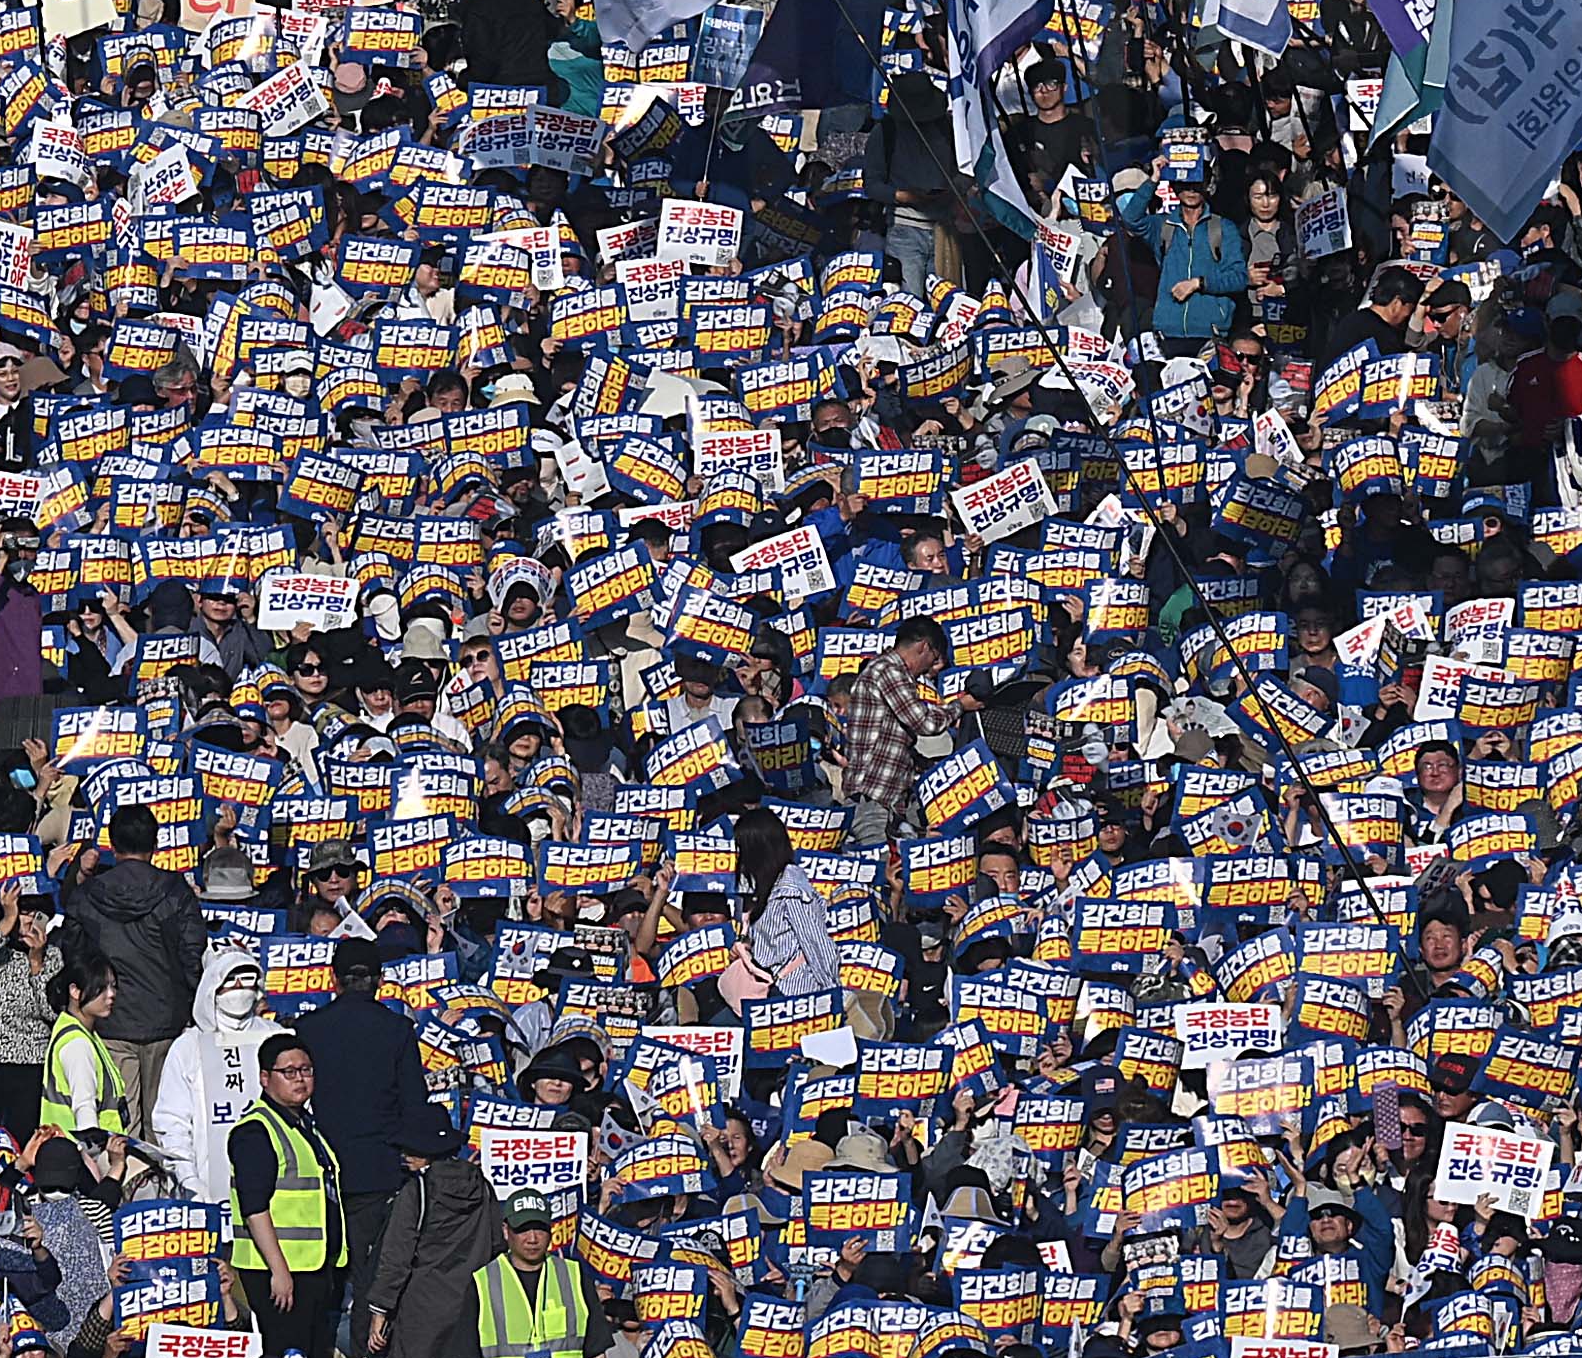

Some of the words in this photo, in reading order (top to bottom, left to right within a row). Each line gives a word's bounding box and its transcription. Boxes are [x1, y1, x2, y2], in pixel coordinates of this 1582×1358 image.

[1188, 1007, 1270, 1029] 국정농단
[1187, 1029, 1277, 1052] 진상규명!
[1454, 1133, 1548, 1164] 국정농단
[1448, 1158, 1542, 1188] 진상규명!
